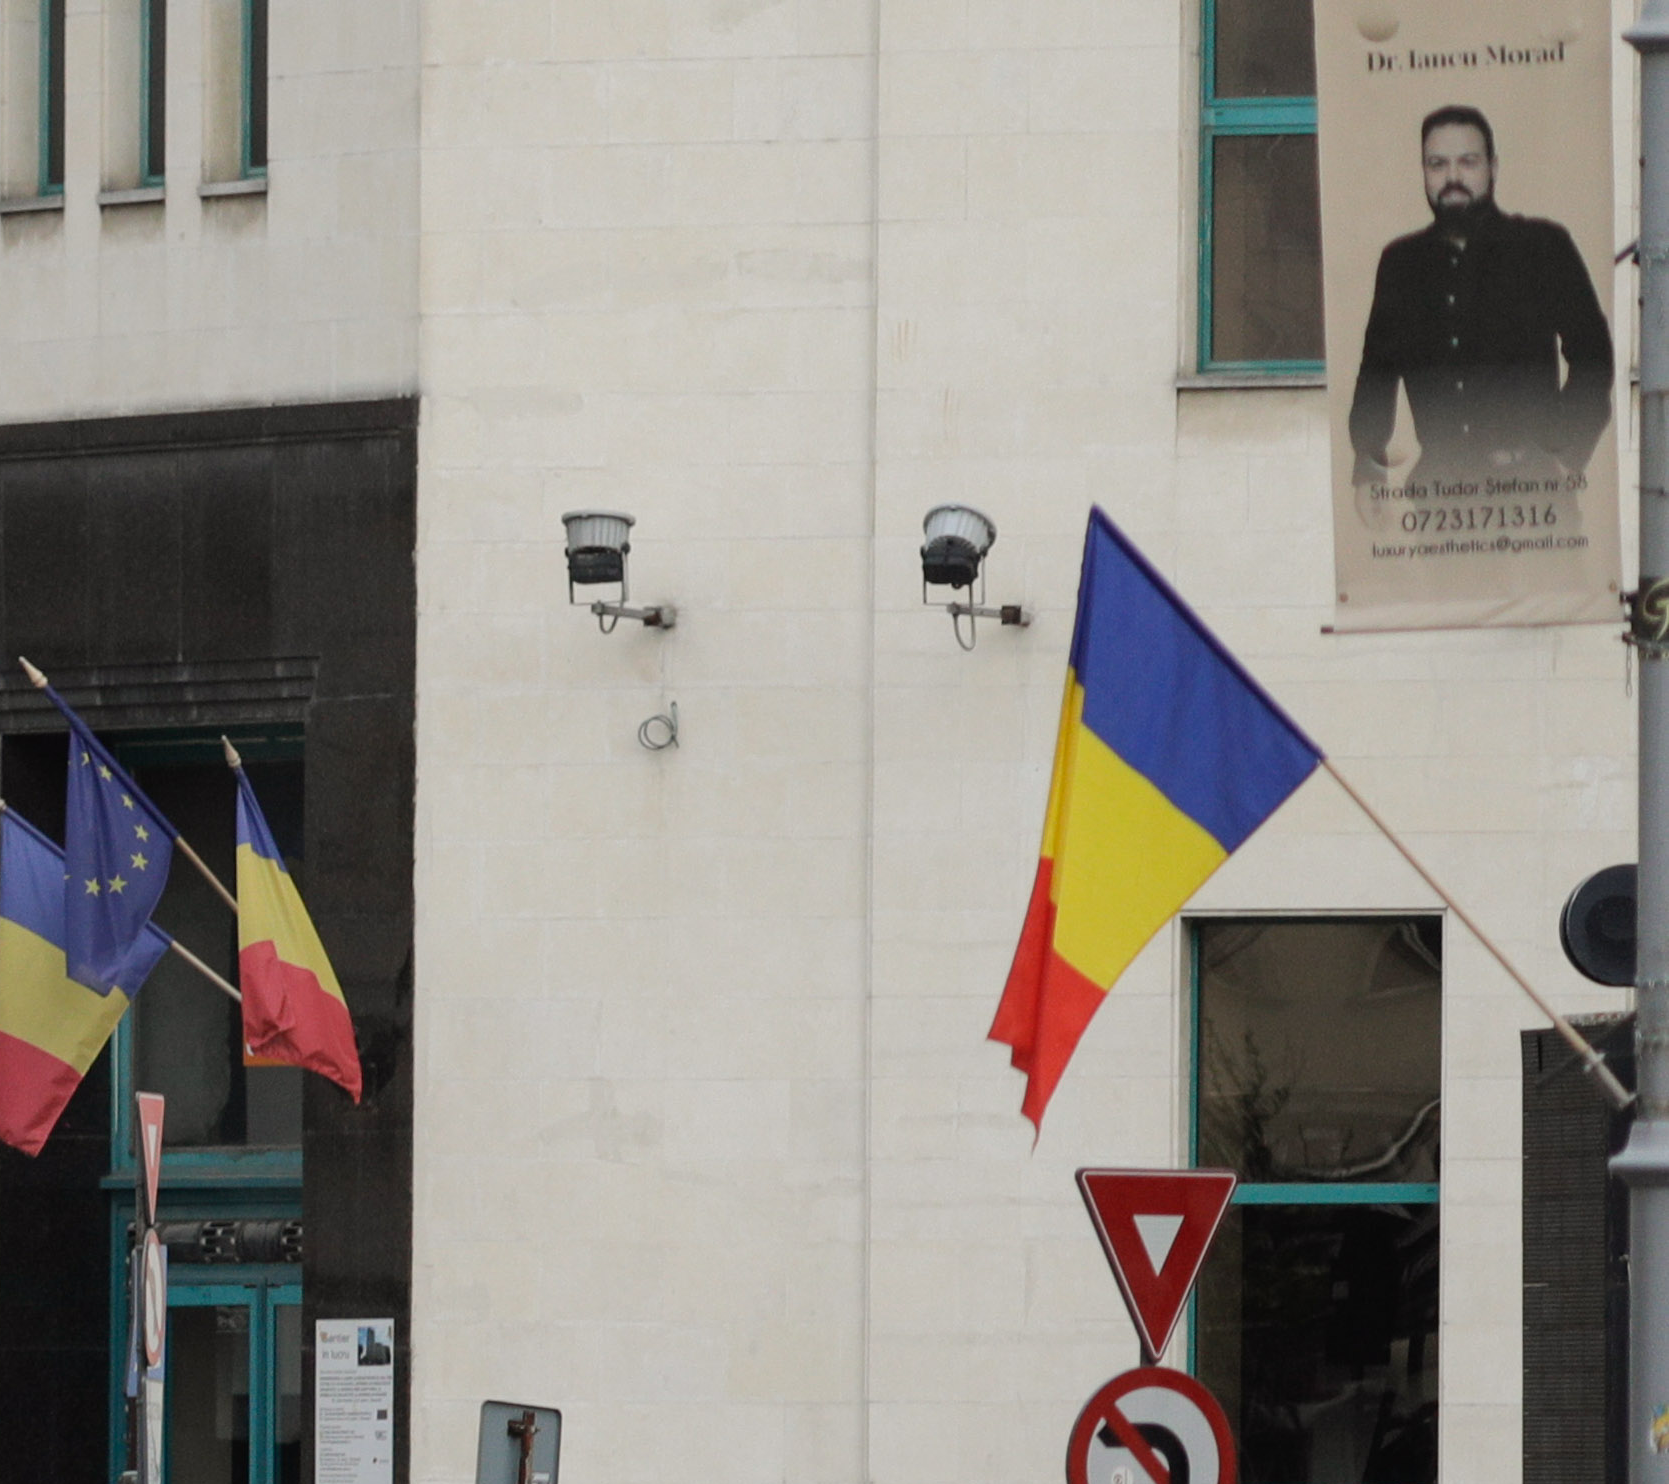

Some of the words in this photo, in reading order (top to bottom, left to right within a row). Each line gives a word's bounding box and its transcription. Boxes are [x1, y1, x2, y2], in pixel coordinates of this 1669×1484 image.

[1486, 41, 1564, 65] Morad
[1370, 483, 1428, 500] Strada
[1434, 480, 1480, 497] Tudor
[1545, 480, 1559, 493] nr
[1402, 504, 1557, 532] 0723171316
